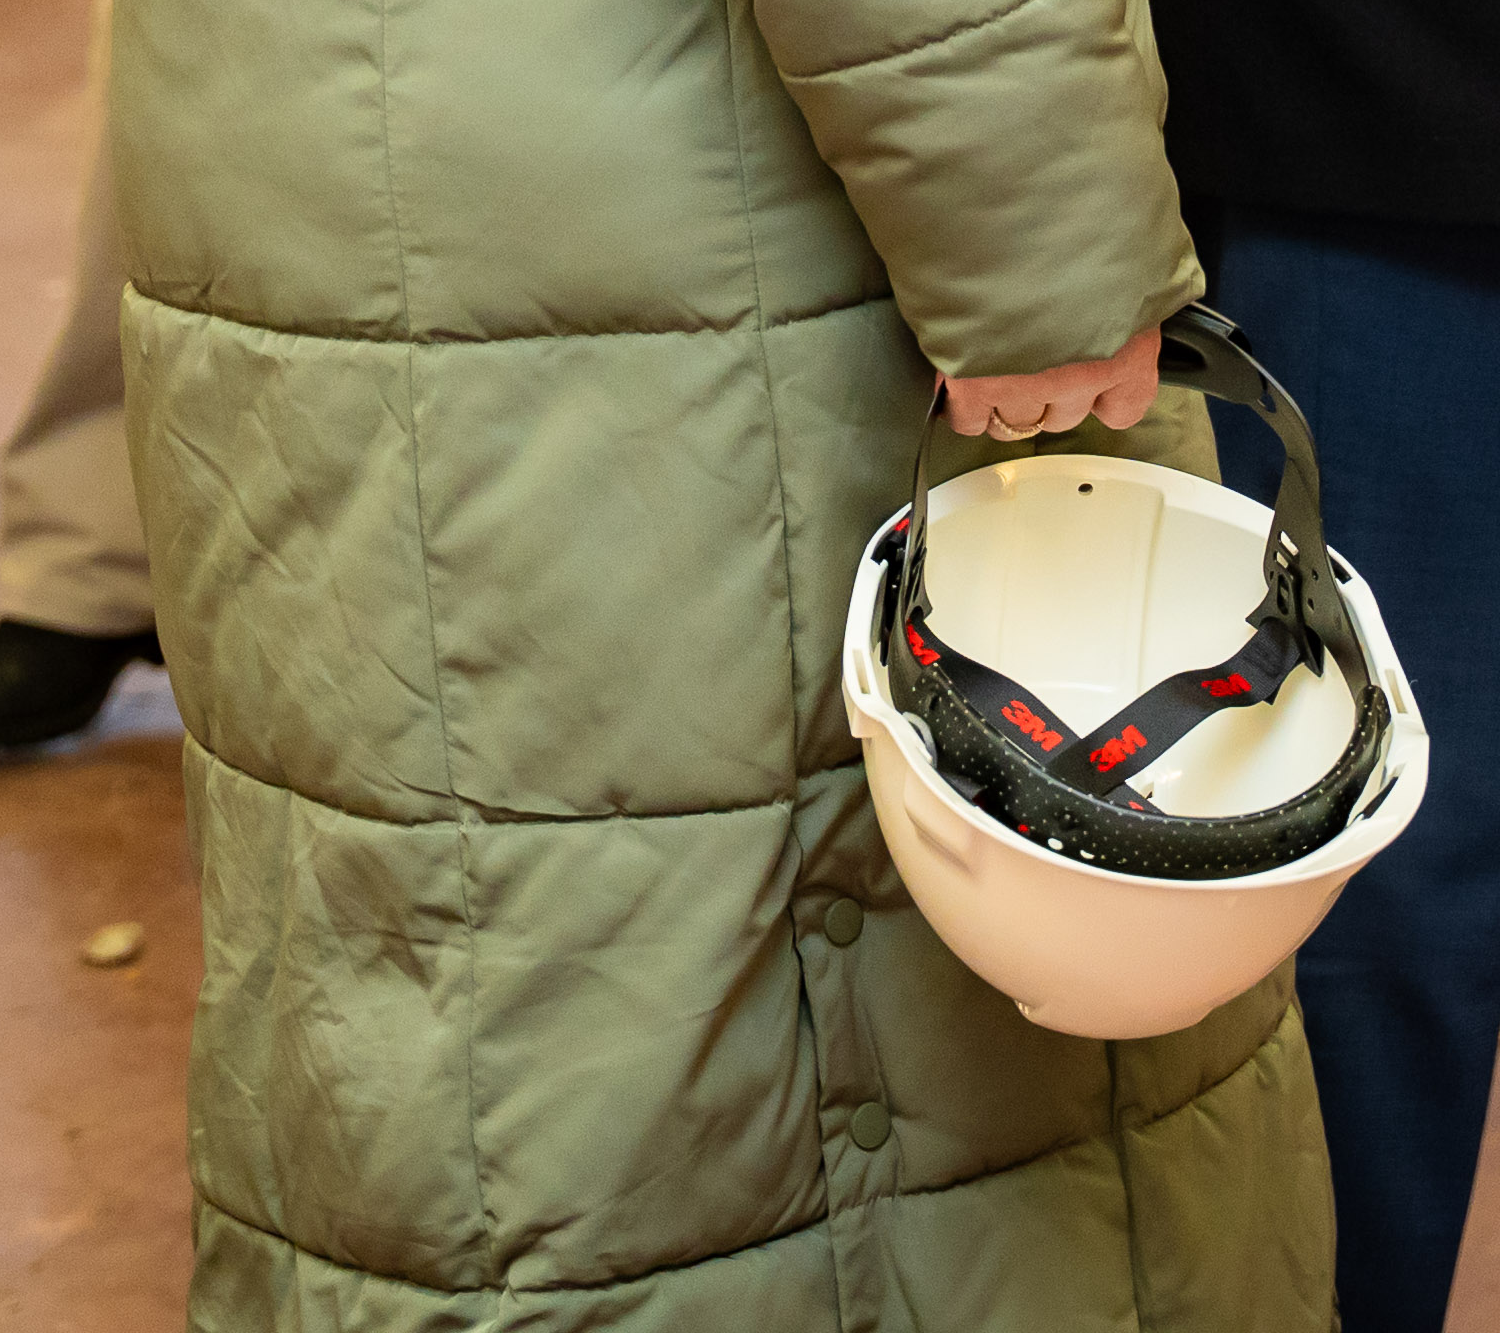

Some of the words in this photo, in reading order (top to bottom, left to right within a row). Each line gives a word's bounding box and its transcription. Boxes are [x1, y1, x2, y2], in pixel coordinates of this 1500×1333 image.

[906, 621, 941, 666] M
[1201, 672, 1252, 697] 3M
[1001, 699, 1064, 752] 3M
[1089, 724, 1148, 773] 3M
